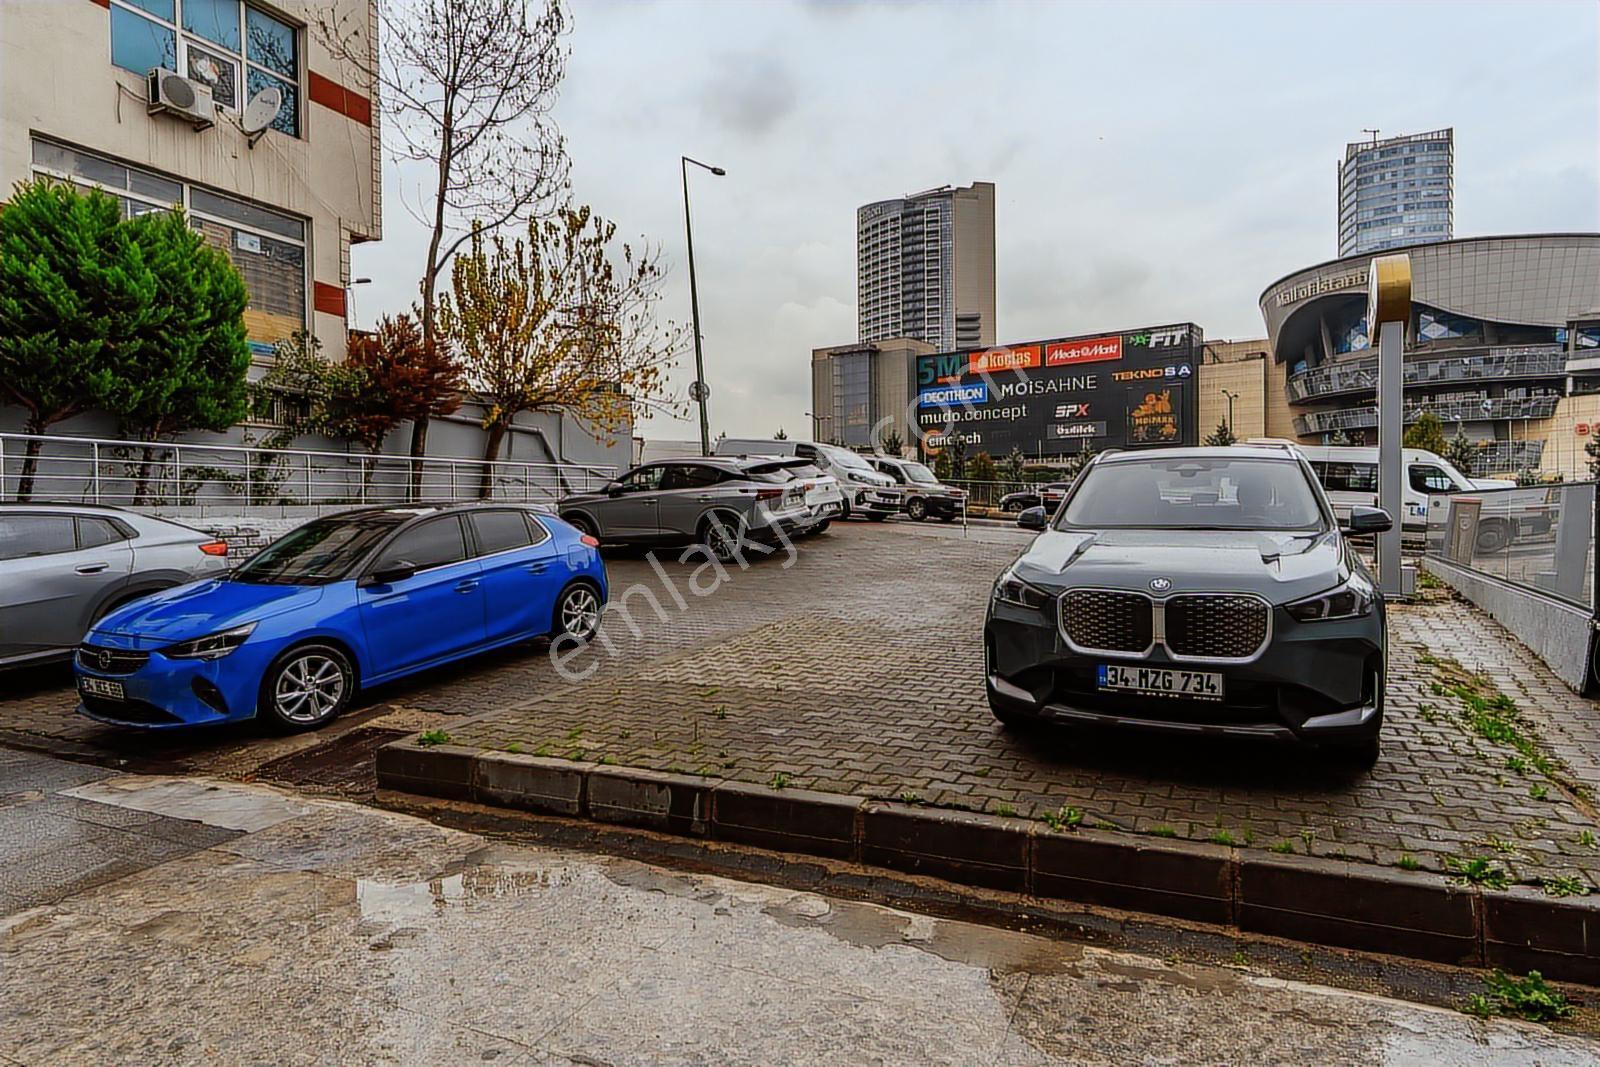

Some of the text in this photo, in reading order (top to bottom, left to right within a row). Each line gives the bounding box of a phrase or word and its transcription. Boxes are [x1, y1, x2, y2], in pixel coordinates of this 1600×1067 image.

[1055, 403, 1089, 418] SPX
[1108, 666, 1217, 693] 34 MZG 734
